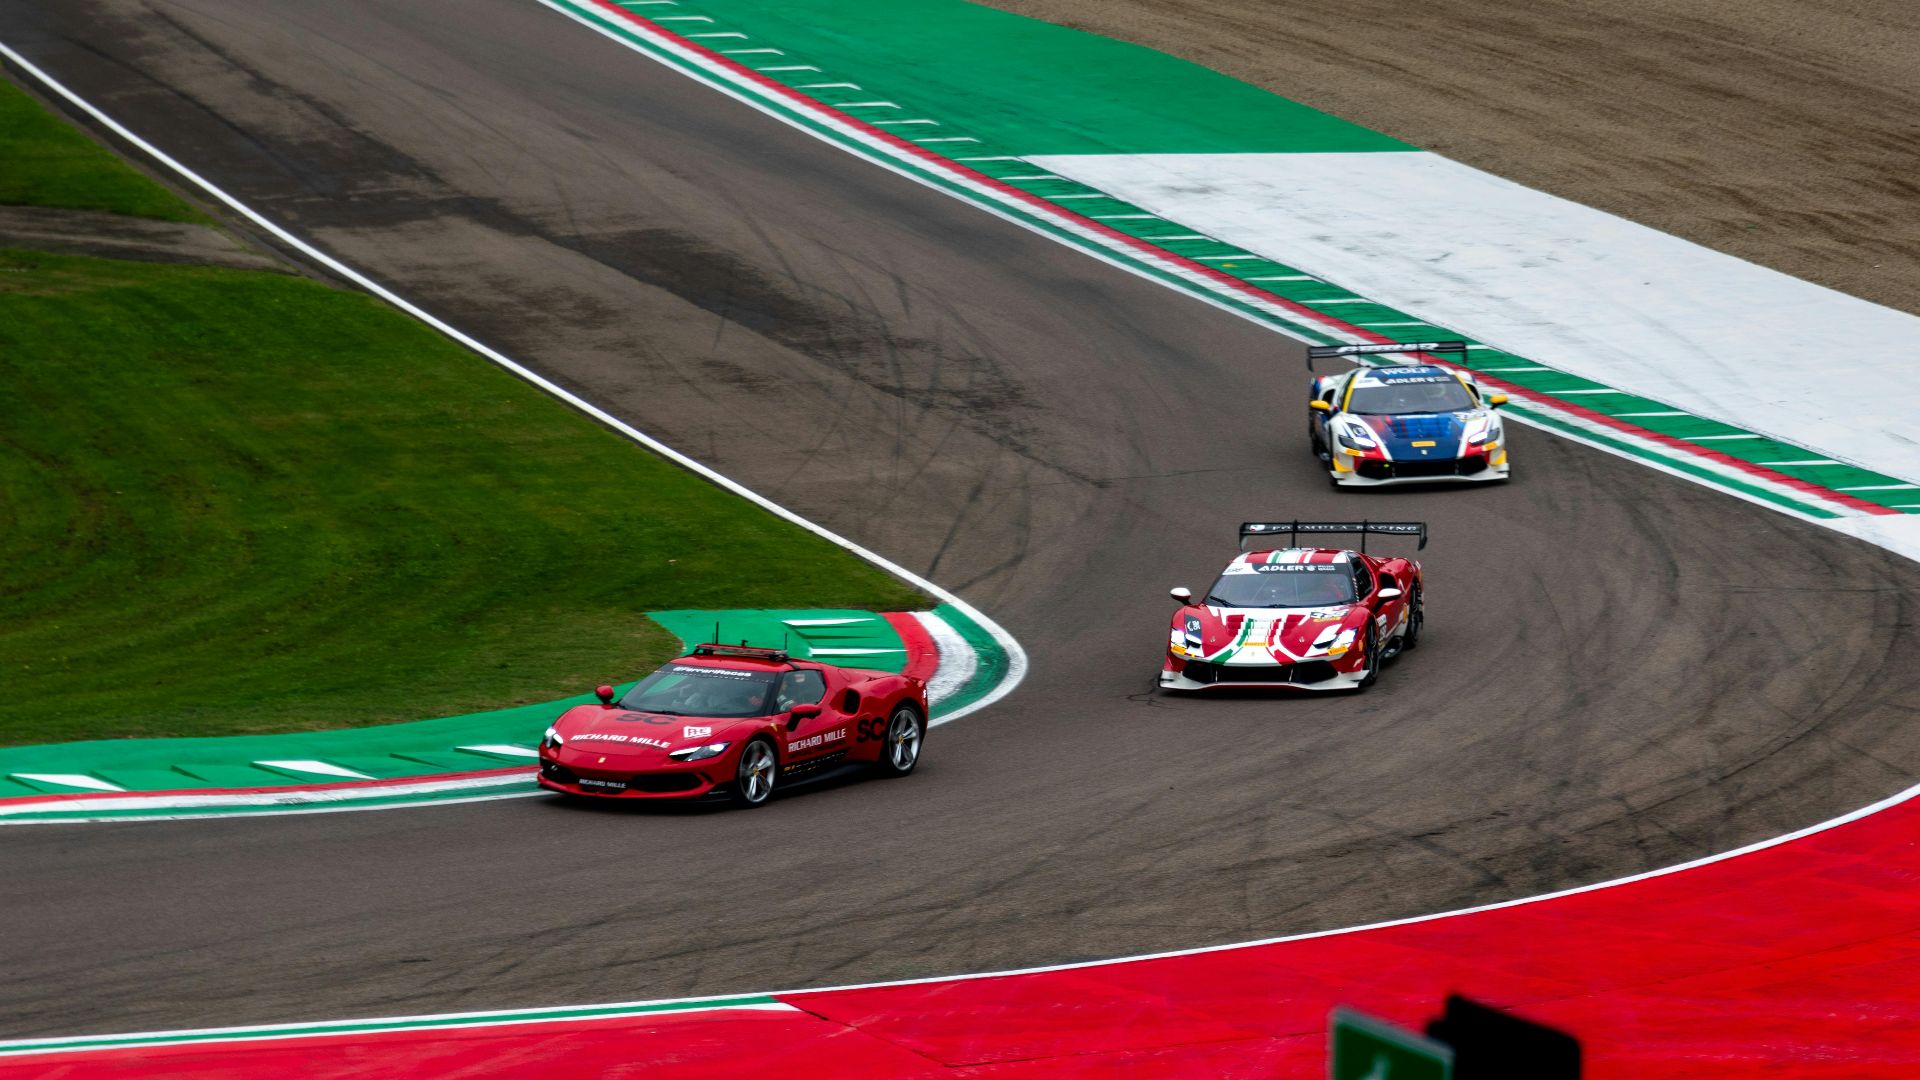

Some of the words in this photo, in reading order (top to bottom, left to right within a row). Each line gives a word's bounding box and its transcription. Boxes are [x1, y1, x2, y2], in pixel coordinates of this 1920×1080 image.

[1385, 377, 1426, 385] ADLER
[615, 713, 678, 725] SC
[856, 717, 886, 743] SC
[570, 733, 628, 742] RICHARD
[629, 736, 672, 749] MILLE
[788, 734, 822, 753] RICHARD
[824, 728, 847, 743] MILLE
[579, 778, 606, 787] RICHARD
[607, 781, 627, 789] MILLE
